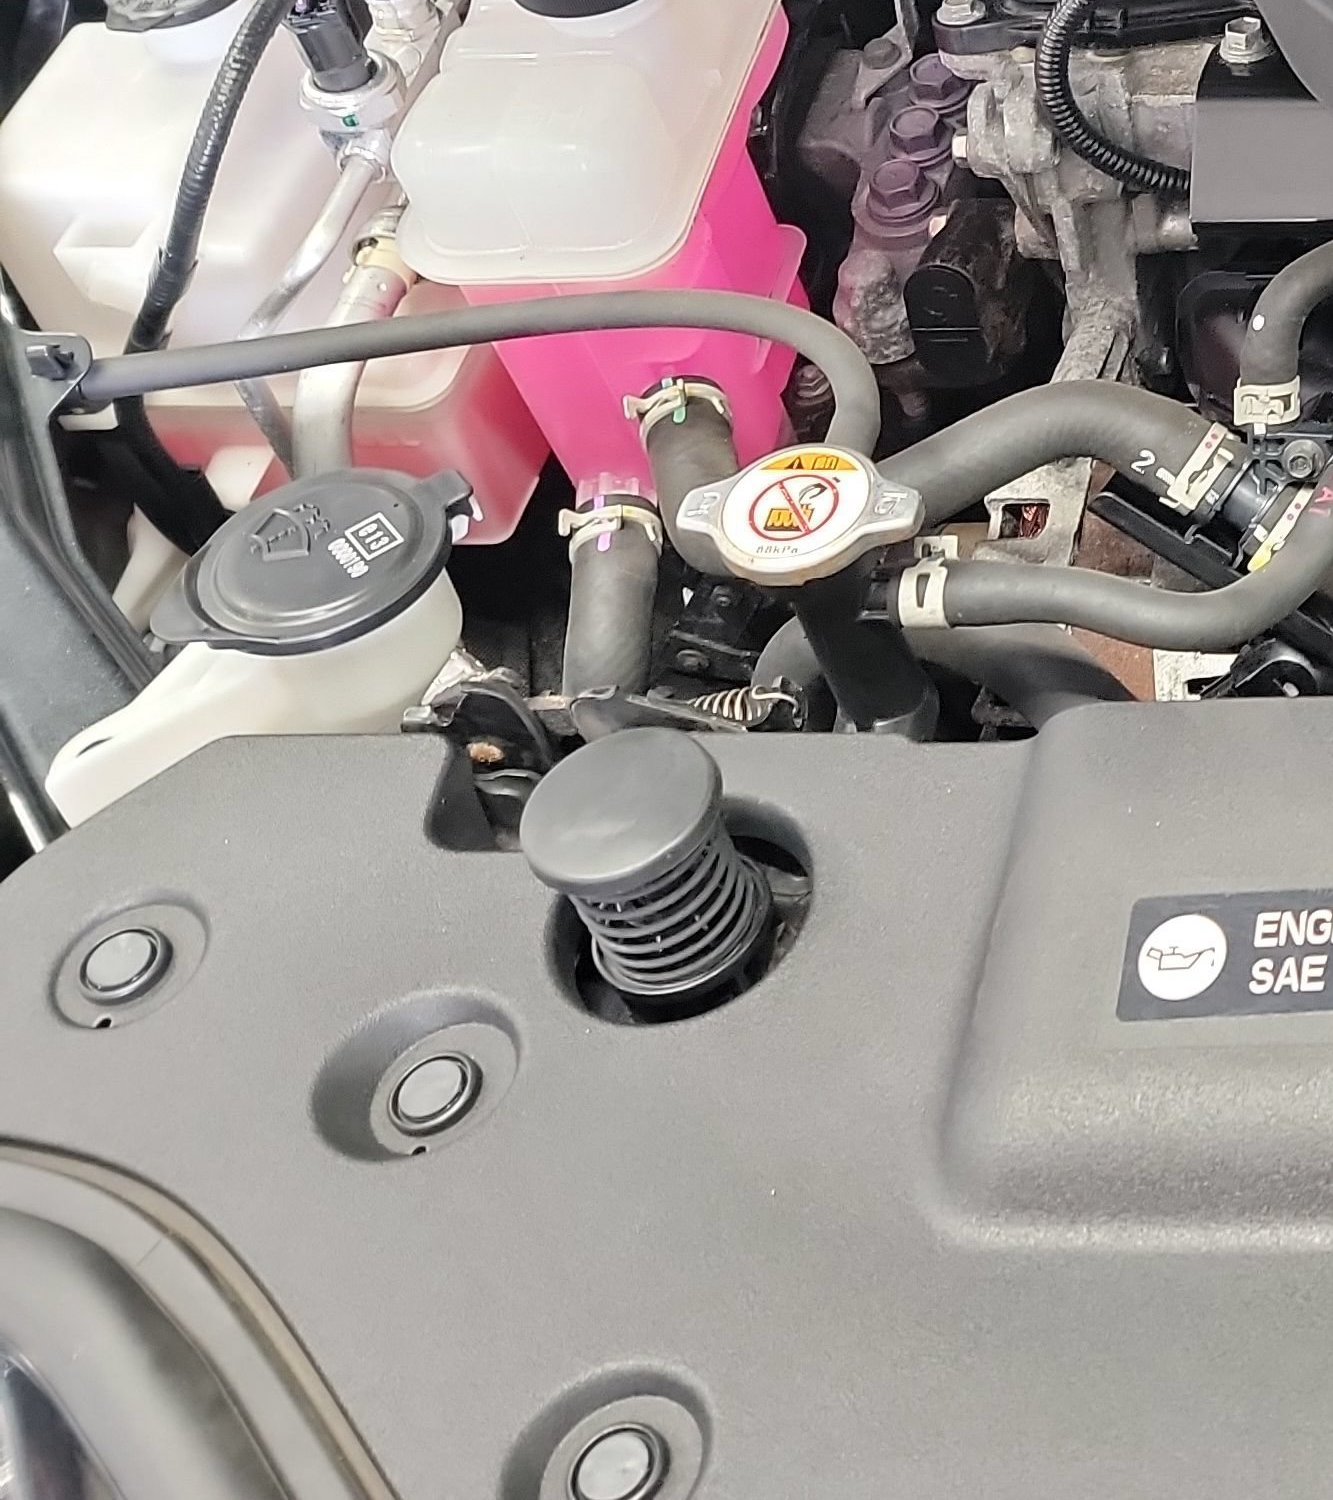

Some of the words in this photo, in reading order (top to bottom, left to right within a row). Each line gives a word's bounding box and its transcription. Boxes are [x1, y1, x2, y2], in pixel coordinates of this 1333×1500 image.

[1131, 449, 1156, 475] 2
[358, 522, 390, 550] e13
[1248, 954, 1329, 995] SAE
